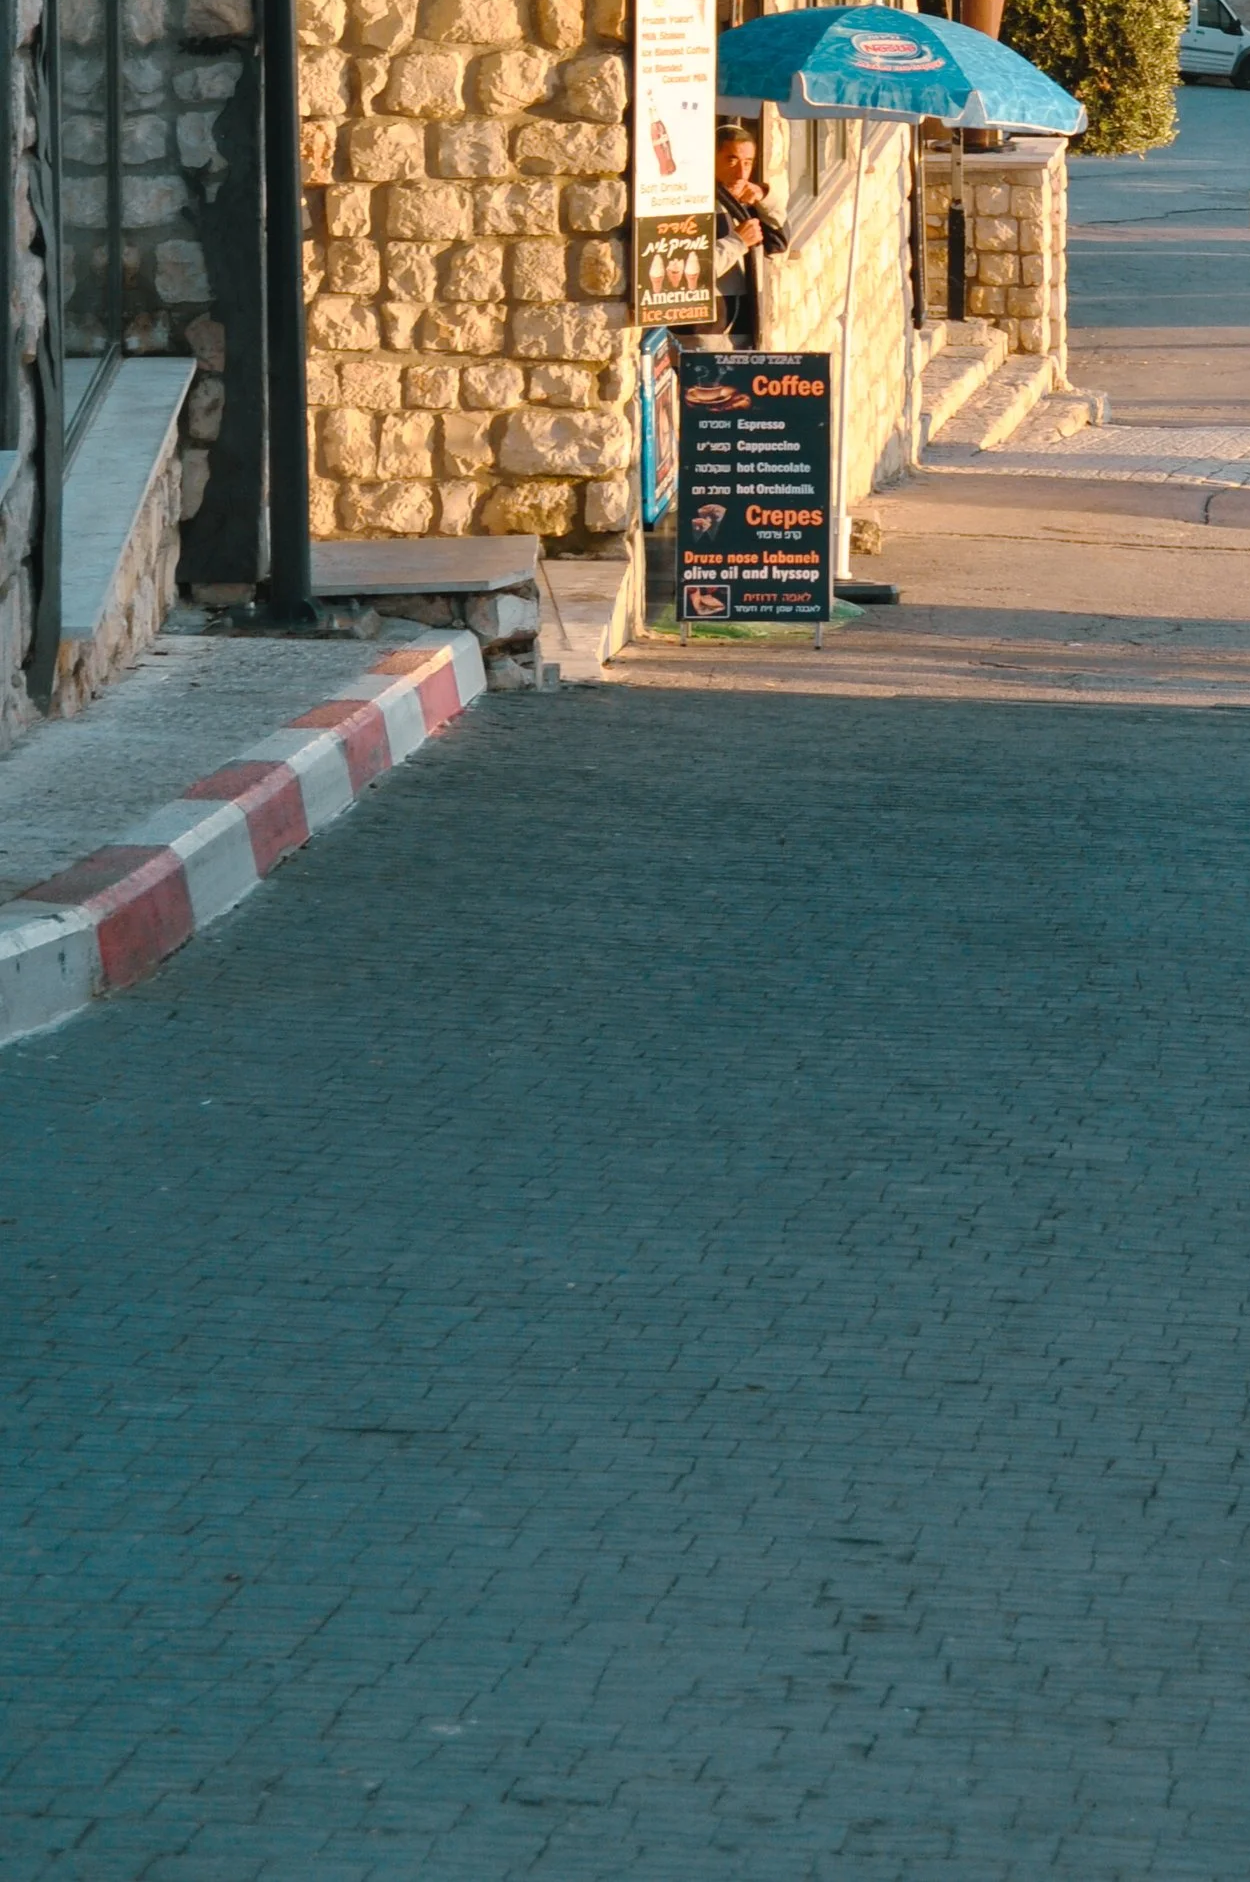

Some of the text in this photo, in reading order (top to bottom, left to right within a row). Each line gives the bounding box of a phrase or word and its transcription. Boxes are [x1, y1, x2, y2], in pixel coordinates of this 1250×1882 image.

[686, 45, 710, 55] Coffee
[640, 181, 688, 194] Soft Drinks
[656, 215, 698, 235] גלידה
[641, 235, 710, 259] אמריקאית
[640, 287, 711, 306] American
[642, 305, 709, 322] ice cream
[714, 355, 750, 365] TASTE
[752, 374, 825, 397] Coffee
[737, 419, 786, 431] Espresso
[737, 440, 801, 453] Cappuccino
[737, 462, 812, 474] hot Chocolate
[737, 483, 815, 495] hot Orchidmilk
[745, 504, 823, 530] Crepes
[684, 550, 820, 564] Druze nose Labaneh
[684, 565, 820, 583] olive oil and hyssop
